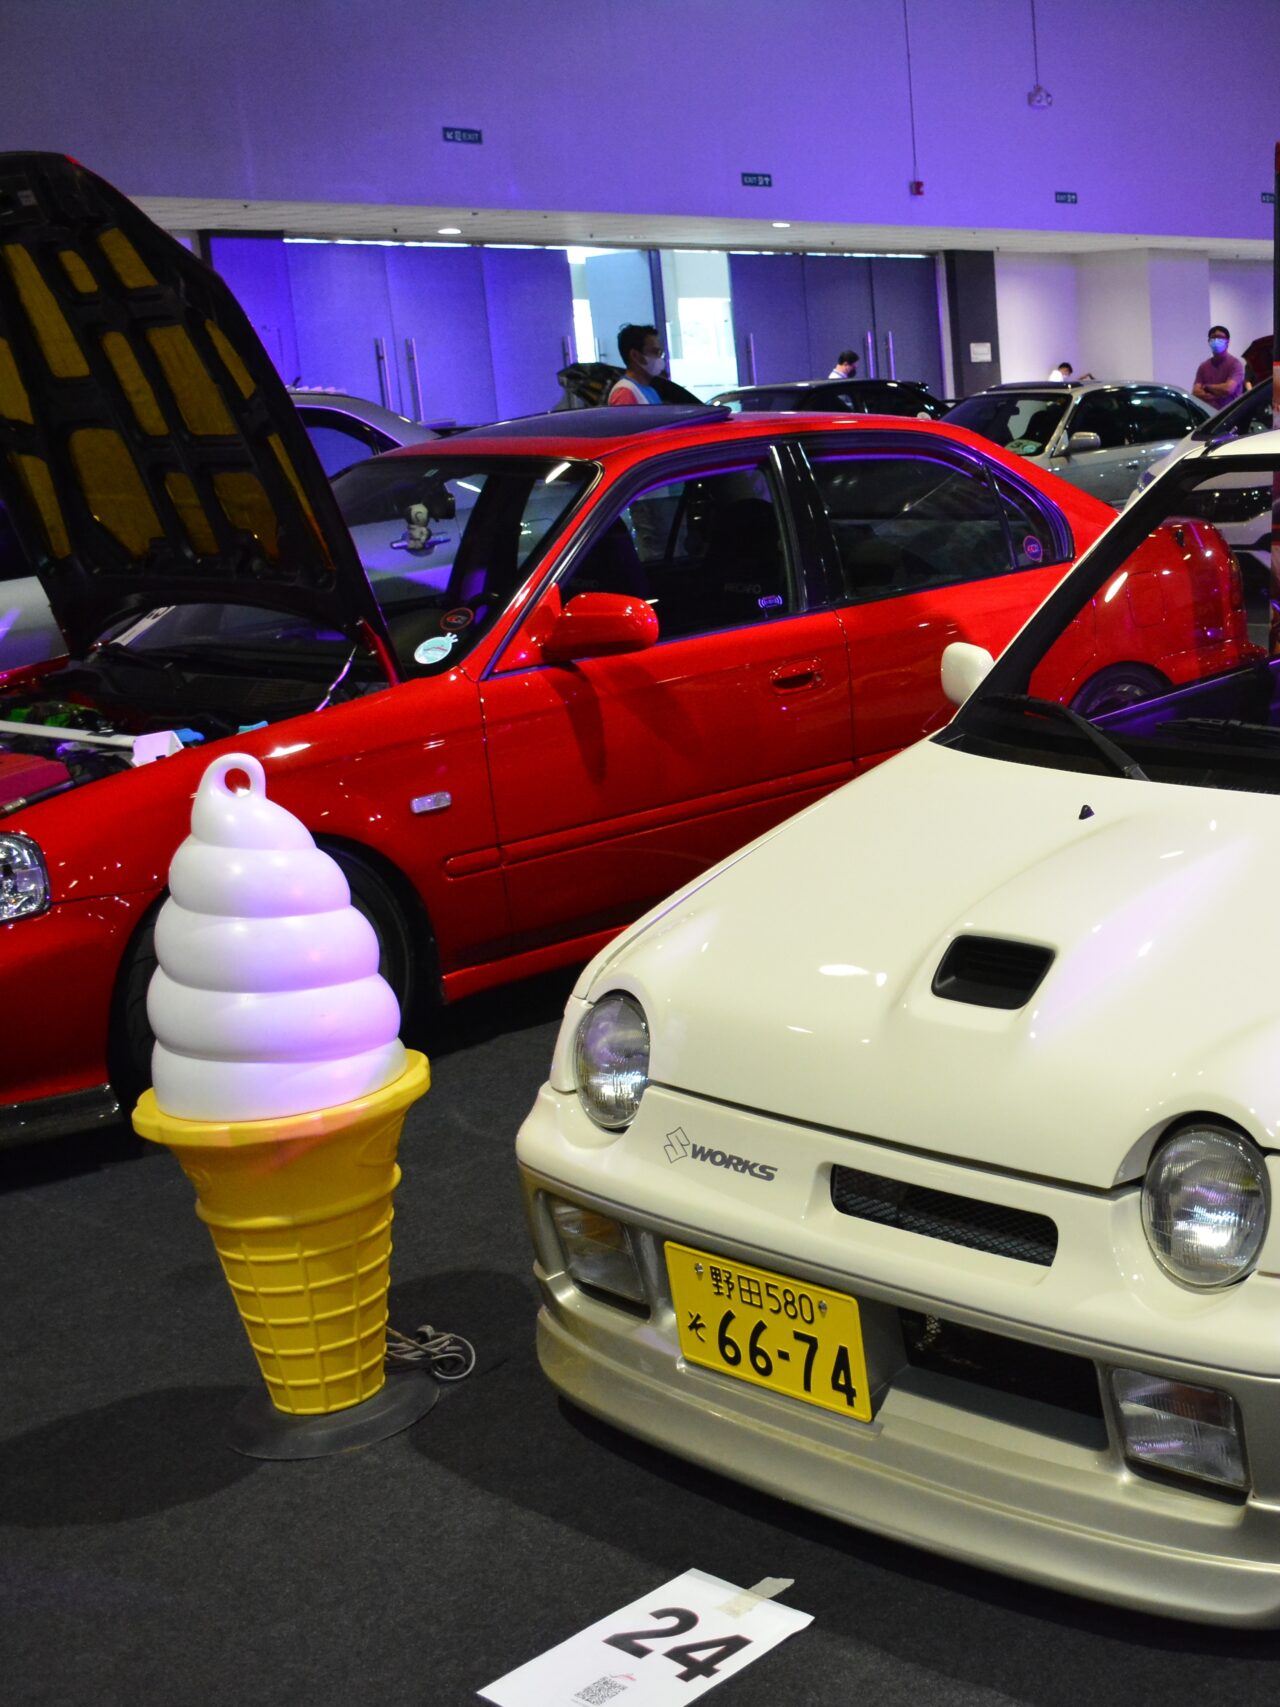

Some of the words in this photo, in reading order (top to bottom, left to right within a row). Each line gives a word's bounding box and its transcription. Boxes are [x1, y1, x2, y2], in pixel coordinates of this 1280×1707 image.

[691, 1142, 778, 1182] WORKS
[688, 1310, 706, 1342] そ
[718, 1309, 857, 1408] 66-74
[602, 1606, 754, 1683] 24
